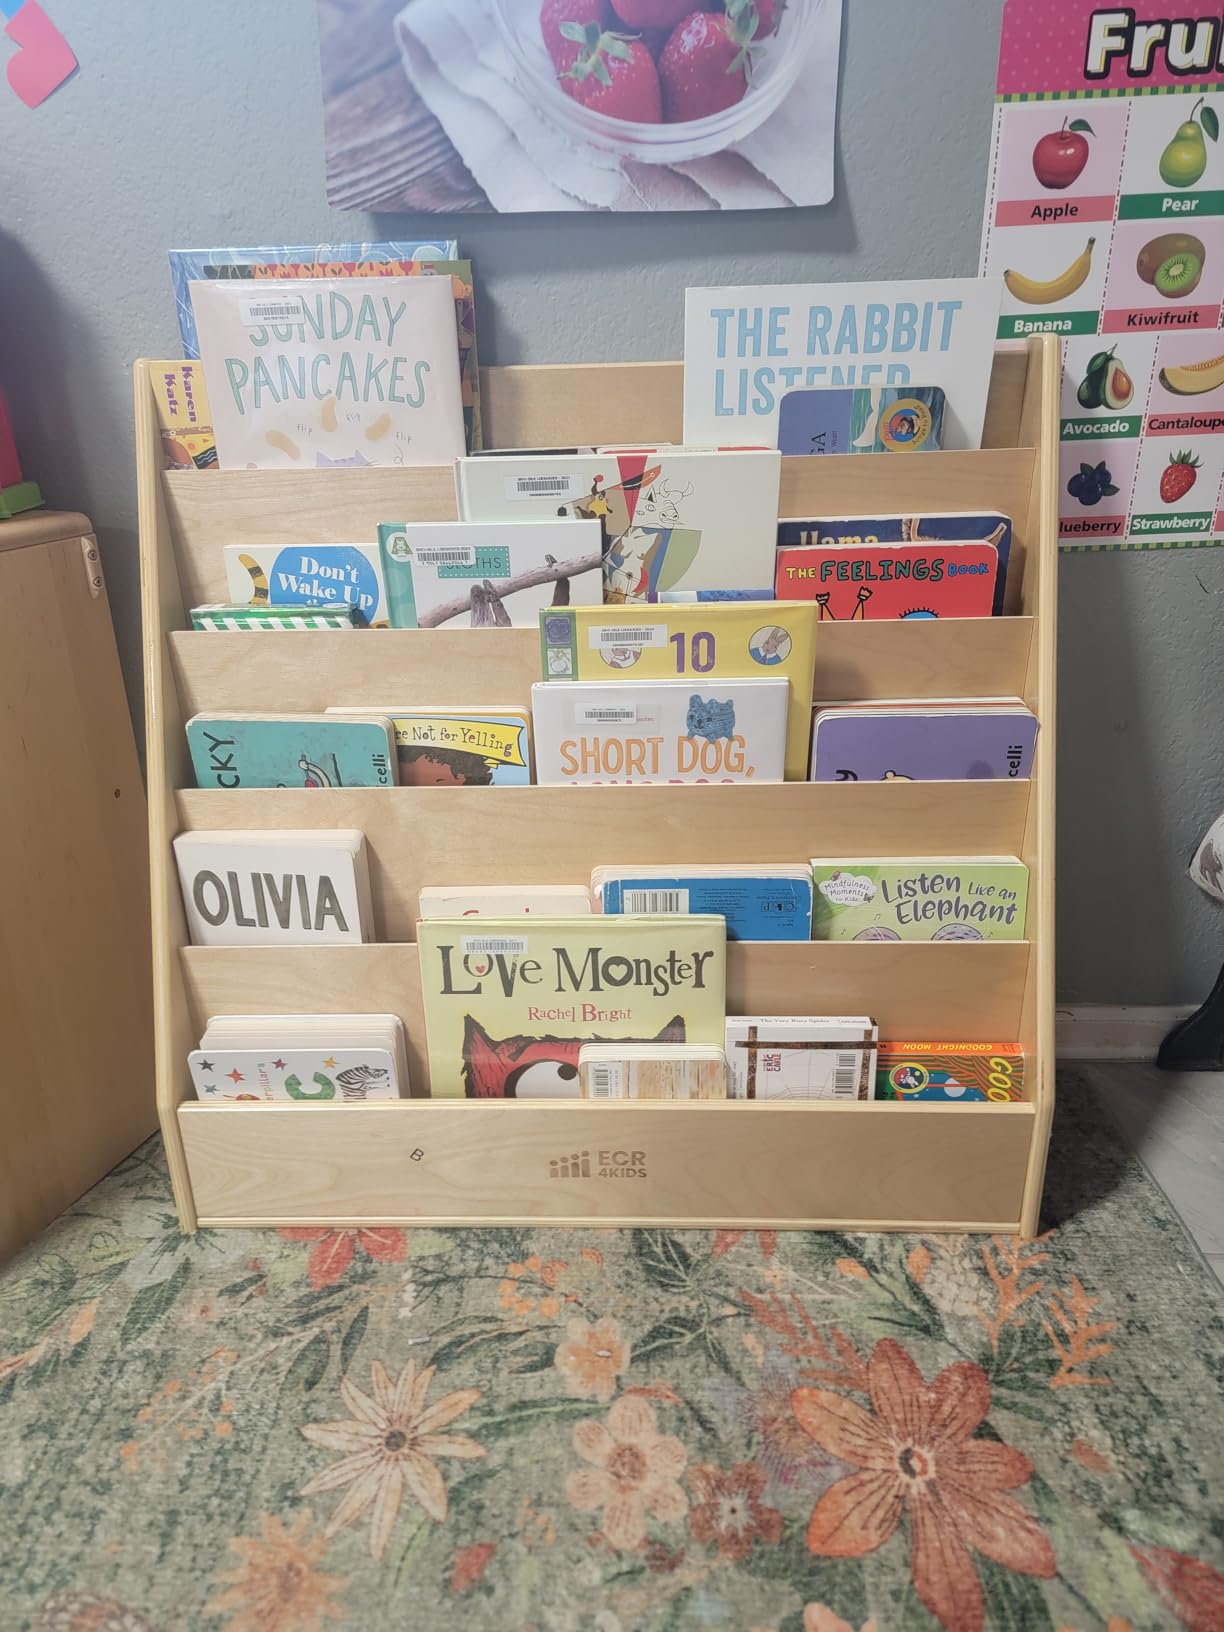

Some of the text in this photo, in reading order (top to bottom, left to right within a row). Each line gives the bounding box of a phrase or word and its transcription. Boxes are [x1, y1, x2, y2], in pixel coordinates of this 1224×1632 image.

[1083, 9, 1224, 80] Fru
[1030, 203, 1079, 220] Apple
[1161, 198, 1199, 212] Pear
[710, 301, 963, 358] THE RABBIT
[1013, 319, 1073, 333] Banana
[1127, 311, 1200, 327] Kiwifruit
[164, 374, 179, 416] Katz
[181, 366, 197, 422] Karen
[224, 352, 431, 415] PANCAKES
[1063, 420, 1130, 435] Avocado
[1059, 520, 1121, 534] lueberry
[1132, 516, 1210, 530] Strawberry
[300, 555, 359, 584] Don't
[785, 559, 989, 582] THE FEELINGS BOOK
[277, 573, 373, 610] Wake Up
[669, 631, 716, 674] 10
[395, 725, 513, 757] re Not for Yelling
[559, 735, 755, 778] SHORT DOG,
[372, 753, 388, 787] celli
[824, 880, 870, 891] Mindfulness
[830, 889, 864, 897] Moments
[881, 873, 961, 903] Listen
[998, 888, 1017, 900] an
[193, 869, 350, 932] OLIVIA
[895, 896, 1018, 925] Elephant
[436, 945, 714, 998] Love Monster
[527, 1003, 633, 1023] Rachel Bright
[936, 1043, 993, 1051] GOODNIGHT
[765, 1054, 774, 1072] ERIC
[410, 1148, 424, 1161] B
[598, 1150, 646, 1166] ECR
[598, 1168, 647, 1178] 4KIDS
